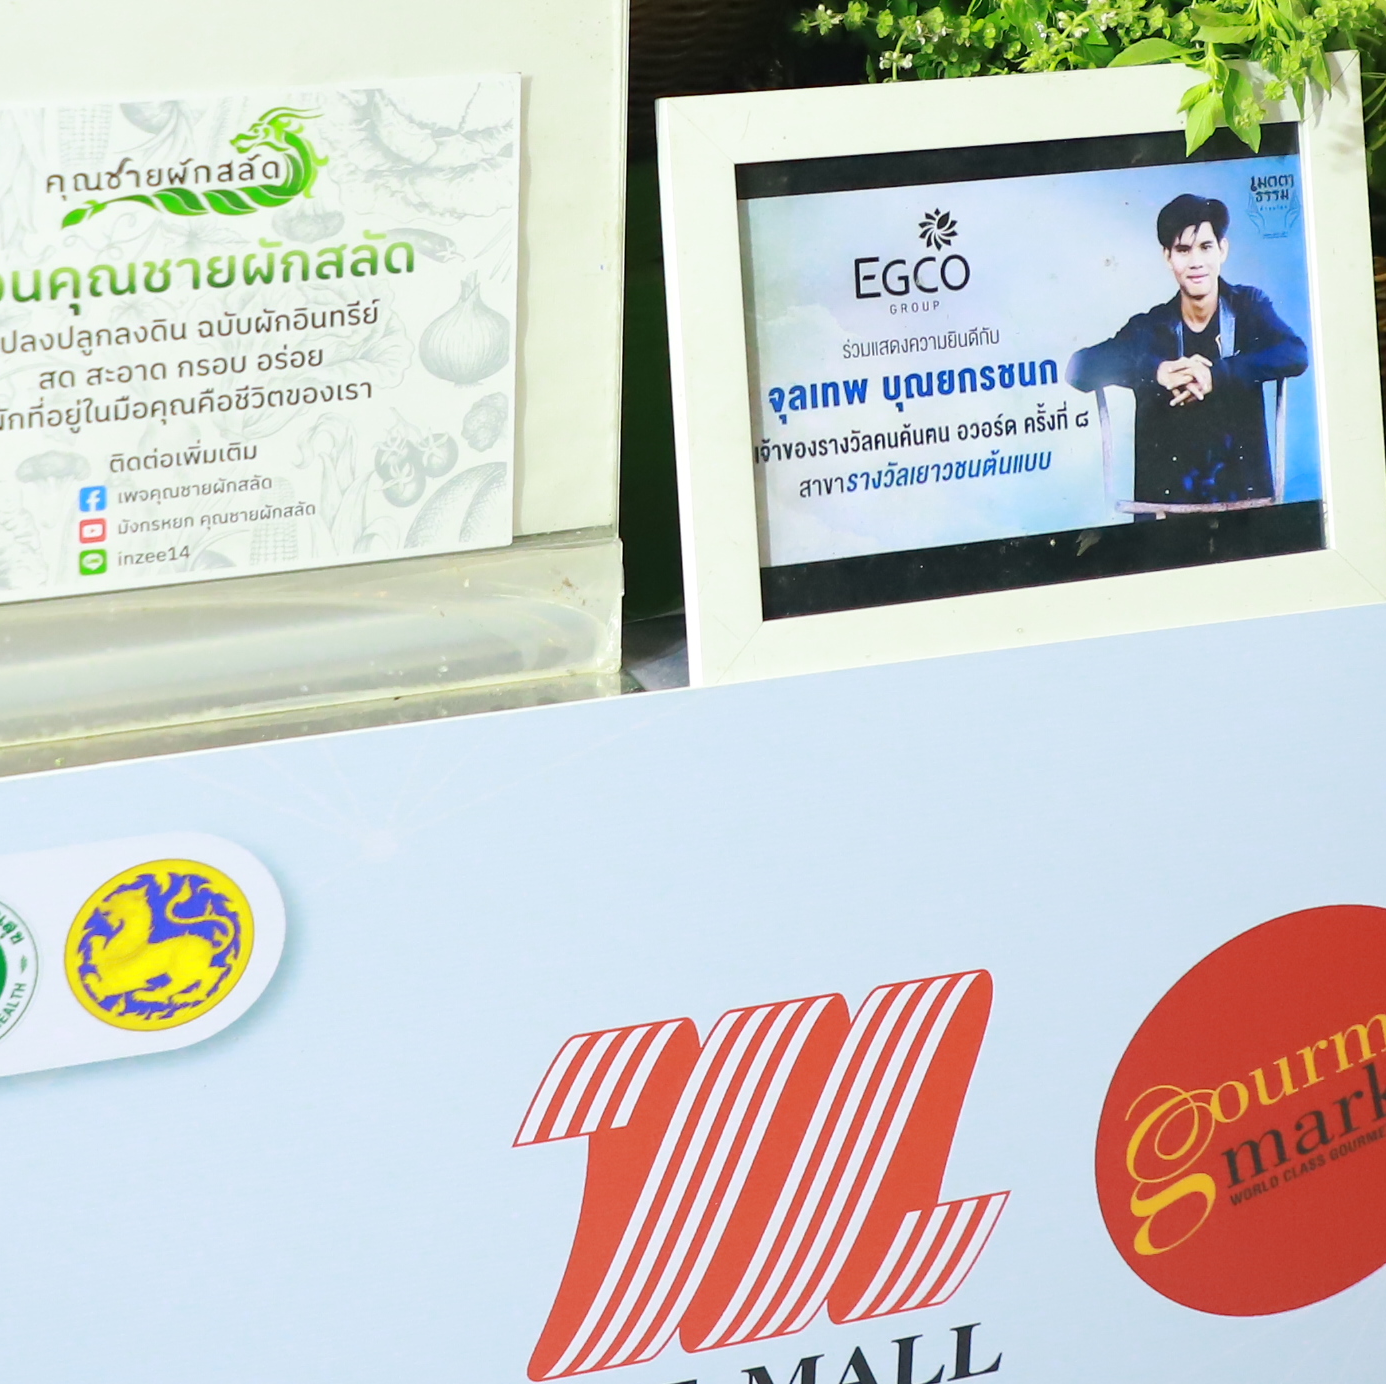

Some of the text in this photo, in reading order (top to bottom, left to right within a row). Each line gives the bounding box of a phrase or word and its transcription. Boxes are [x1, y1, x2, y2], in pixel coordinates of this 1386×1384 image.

[46, 154, 281, 202] คุณชายผักสลัด
[854, 254, 971, 300] EGCO
[197, 298, 381, 340] ฉบับผักอินทรีย์
[889, 300, 941, 315] GROUP
[842, 326, 1001, 359] ร่วมแสดงความยินดีกับ
[38, 344, 325, 391] สด สะอาด กรอบ อร่อย
[769, 358, 1059, 425] จุลเทพ บุณยกรชนก
[957, 413, 1018, 442] อวอร์ด
[1024, 402, 1068, 434] ครั้งที่
[109, 439, 258, 474] ติดต่อเพิ่มเติม
[799, 449, 1053, 499] สาขารางวัลเยาวชนต้นแบบ
[118, 474, 273, 506] เพจคุณชายผักสลัด
[118, 500, 316, 536] มังกรหยก คุณชายผักสลัด
[118, 545, 191, 567] inzee14
[1229, 1176, 1280, 1206] WORLD
[1284, 1154, 1326, 1183] CLASS
